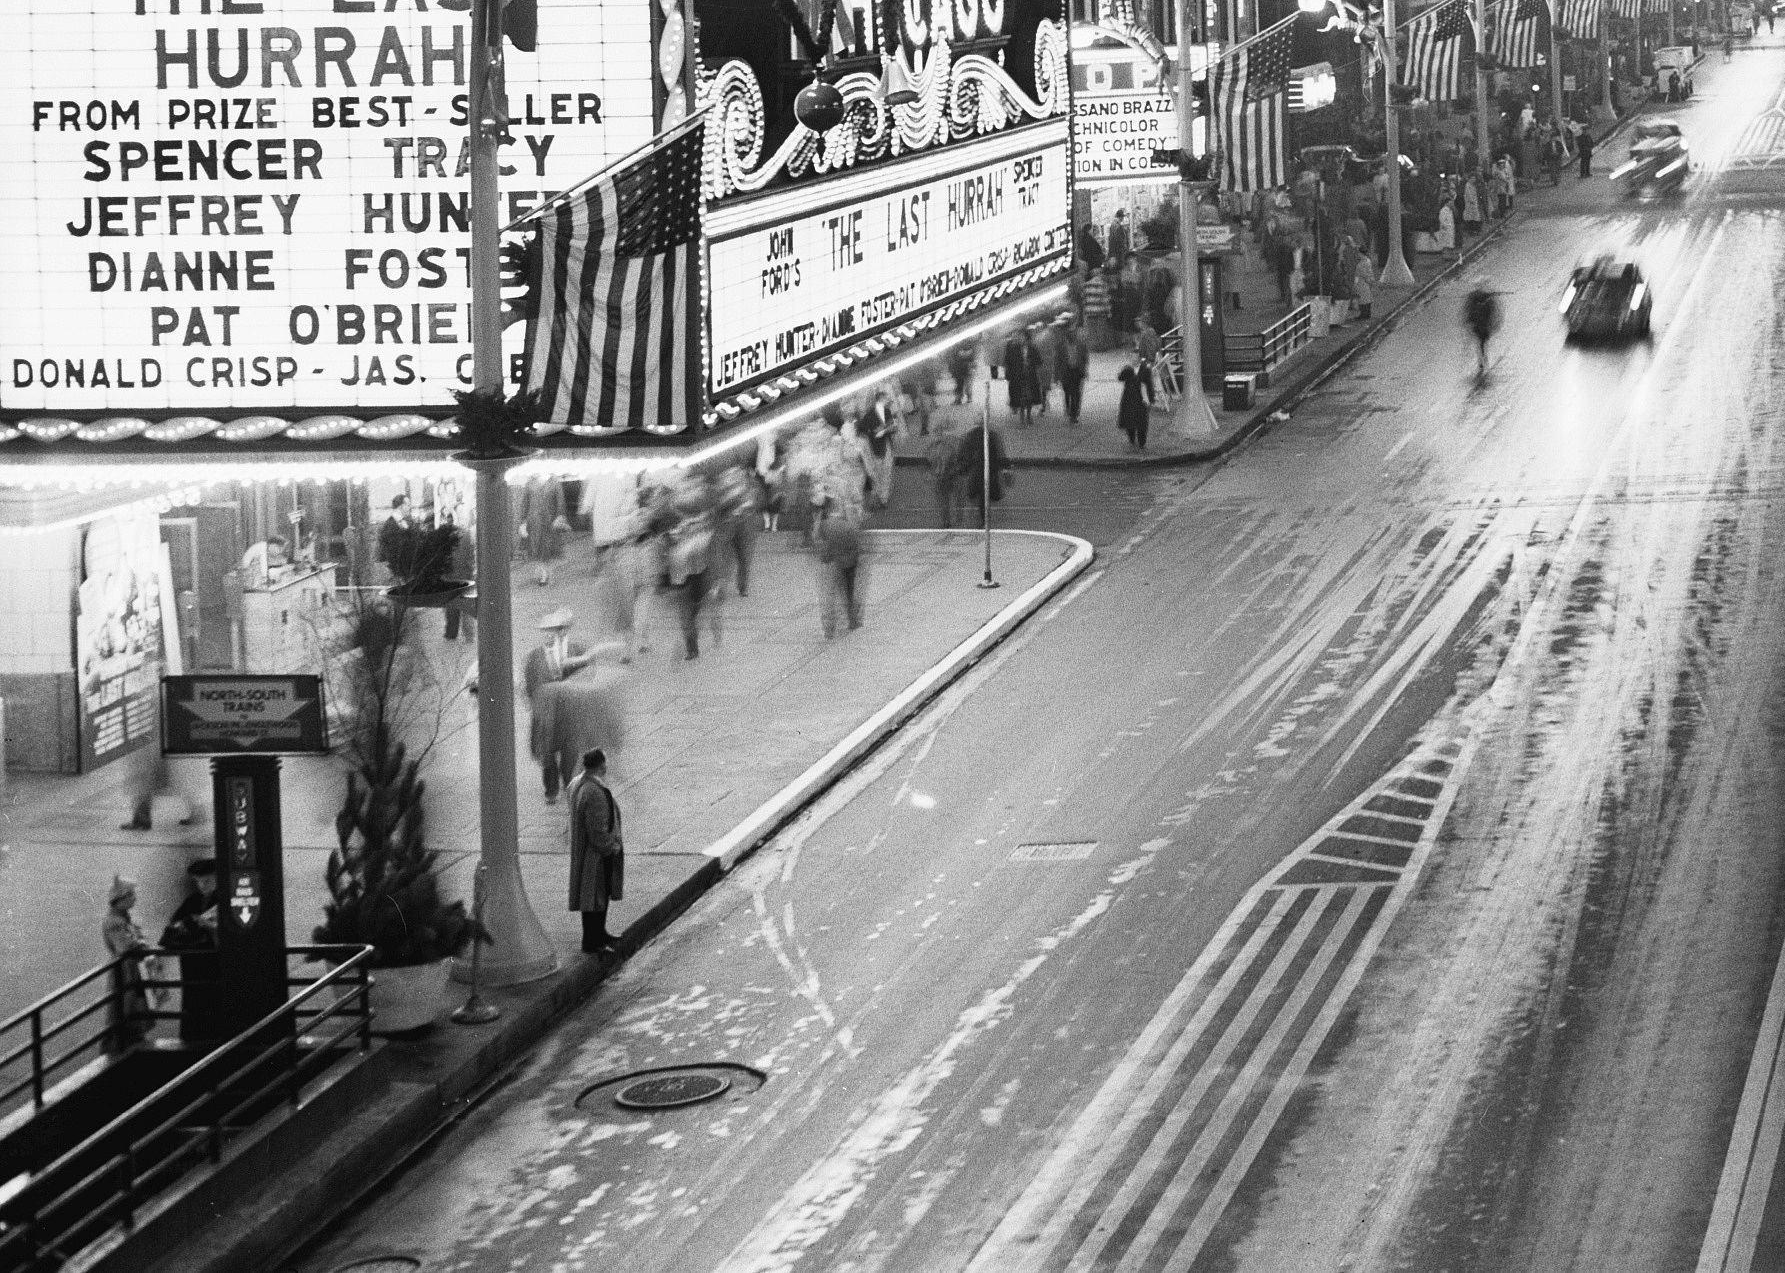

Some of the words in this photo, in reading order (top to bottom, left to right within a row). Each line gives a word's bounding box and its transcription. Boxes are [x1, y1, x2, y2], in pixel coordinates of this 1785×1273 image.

[156, 25, 465, 89] HURRAH
[33, 100, 140, 132] FROM
[168, 98, 277, 130] PRIZE
[83, 138, 323, 182] SPENCER
[66, 193, 300, 236] JEFFREY
[363, 191, 566, 234] HUNE
[887, 191, 931, 253] LAST
[767, 226, 794, 262] JOHN
[88, 250, 275, 292] DIANNE
[761, 258, 800, 299] FORD'S
[151, 305, 240, 347] PAT
[289, 302, 472, 345] O'BRIE
[12, 356, 162, 389] DONALD
[717, 338, 769, 388] JEFFREY
[200, 689, 287, 702] NORTH-SOUTH
[222, 701, 266, 713] TRAINS
